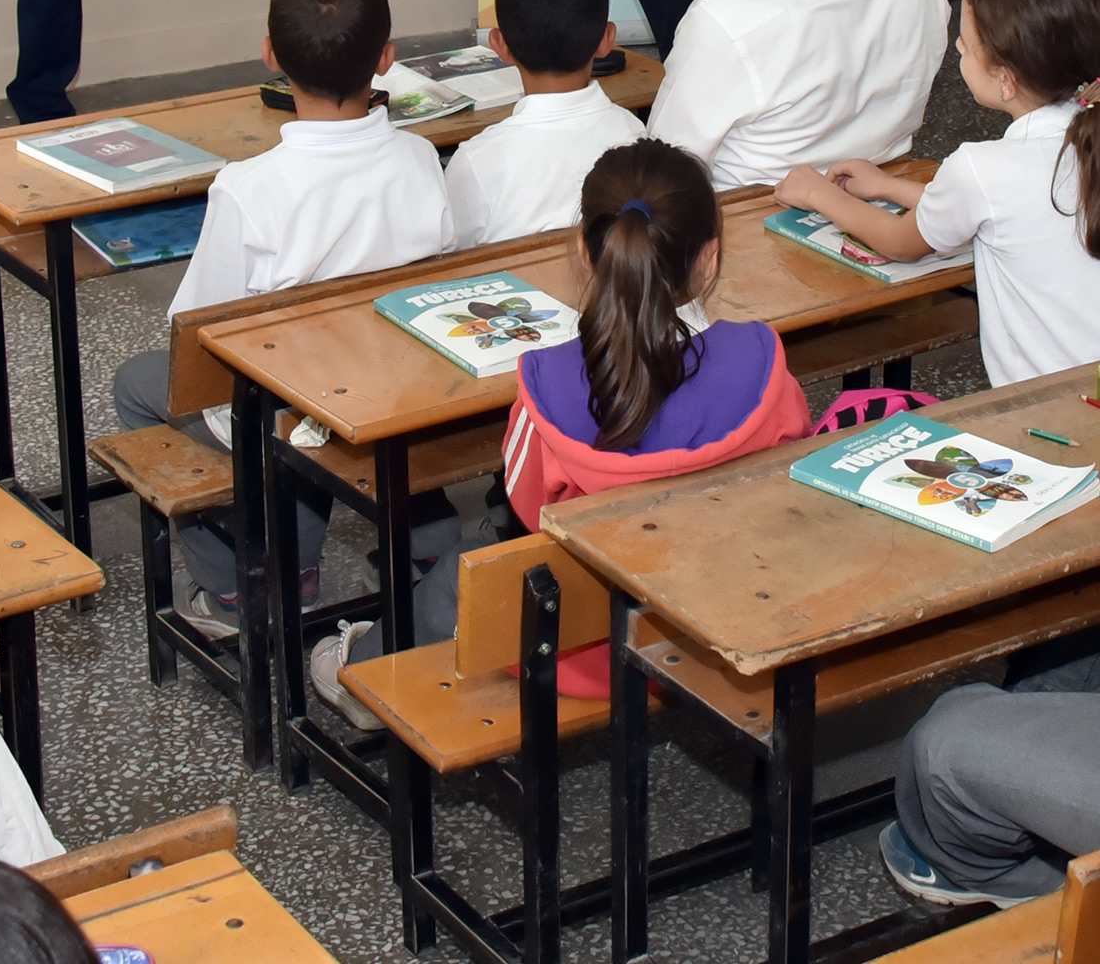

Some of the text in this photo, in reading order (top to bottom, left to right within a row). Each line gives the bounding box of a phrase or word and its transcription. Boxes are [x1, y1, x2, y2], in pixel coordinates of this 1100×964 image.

[405, 280, 514, 308] TÜRKÇE
[494, 318, 515, 328] 5
[831, 426, 932, 474] TÜRKÇE
[954, 473, 979, 487] 5
[813, 478, 840, 496] ORTAOKUL
[880, 502, 913, 519] ORTAOKULU
[913, 515, 936, 528] TÜRKÇE
